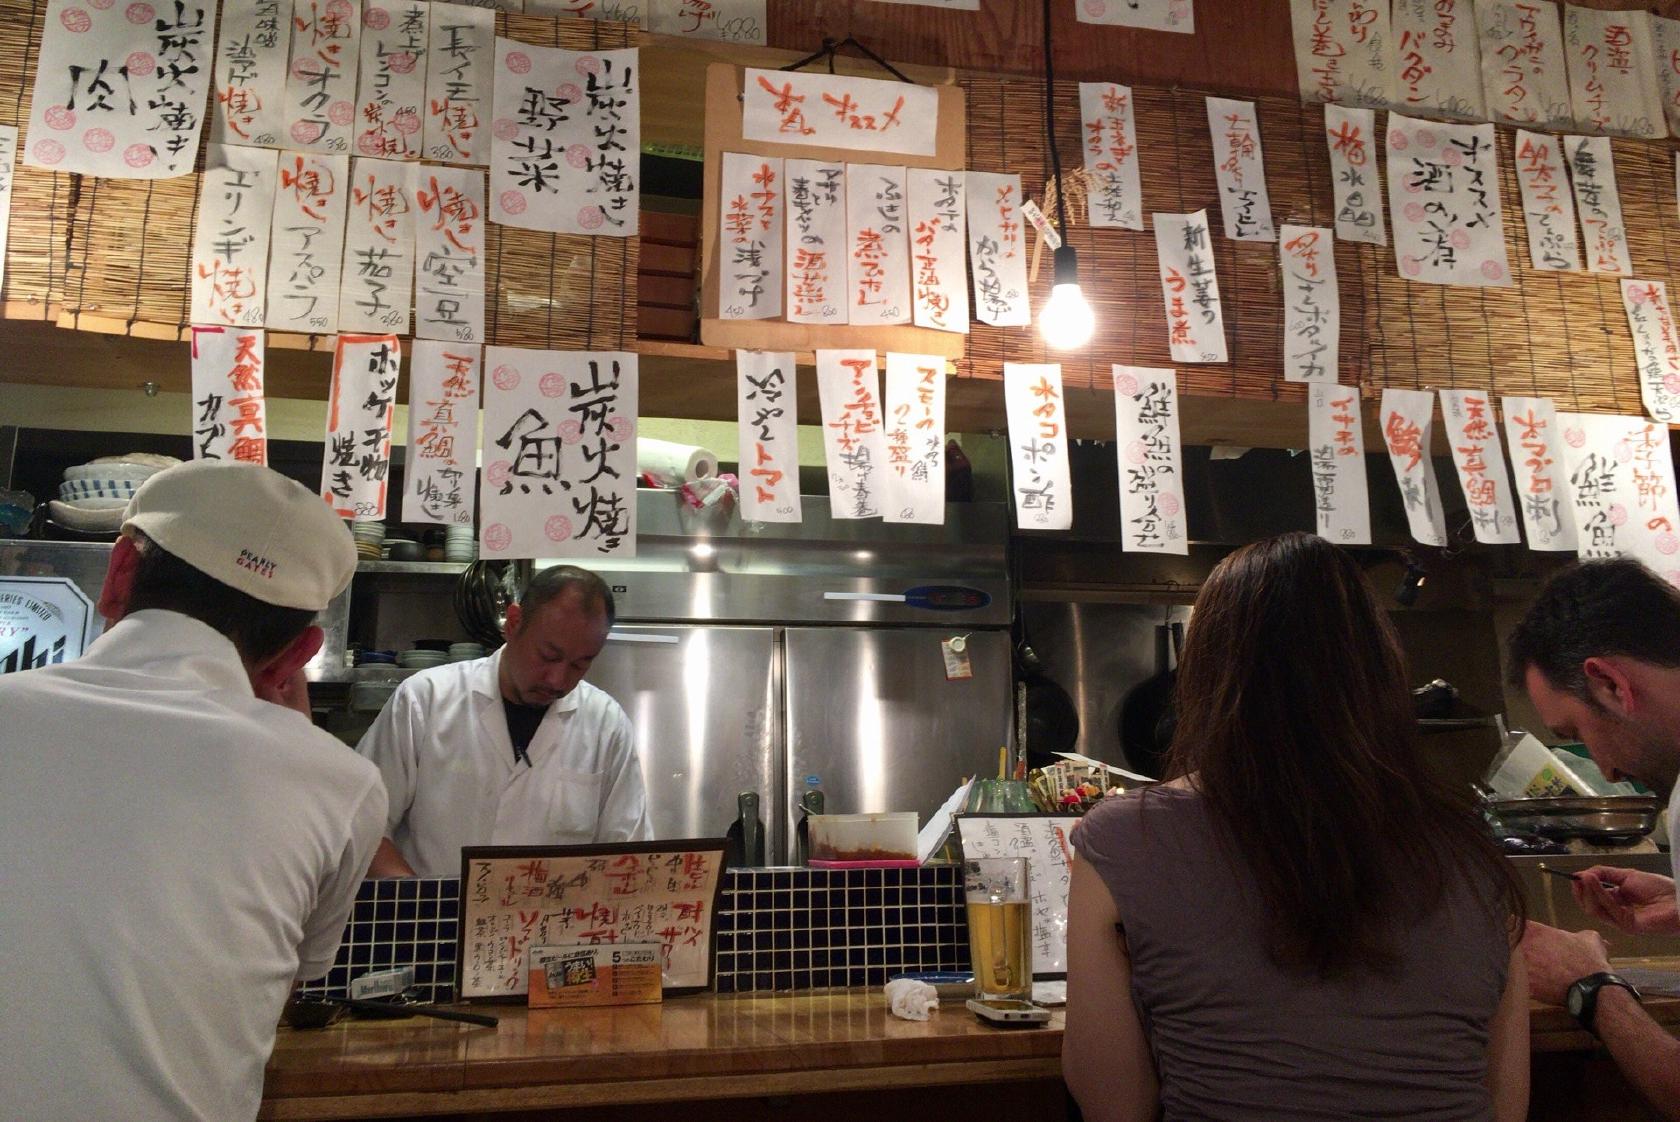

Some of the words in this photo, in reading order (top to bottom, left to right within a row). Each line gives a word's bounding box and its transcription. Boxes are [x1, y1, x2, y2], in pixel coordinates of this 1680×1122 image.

[495, 408, 573, 496] 魚
[240, 549, 278, 570] PEARLY
[25, 599, 52, 622] LIMITED
